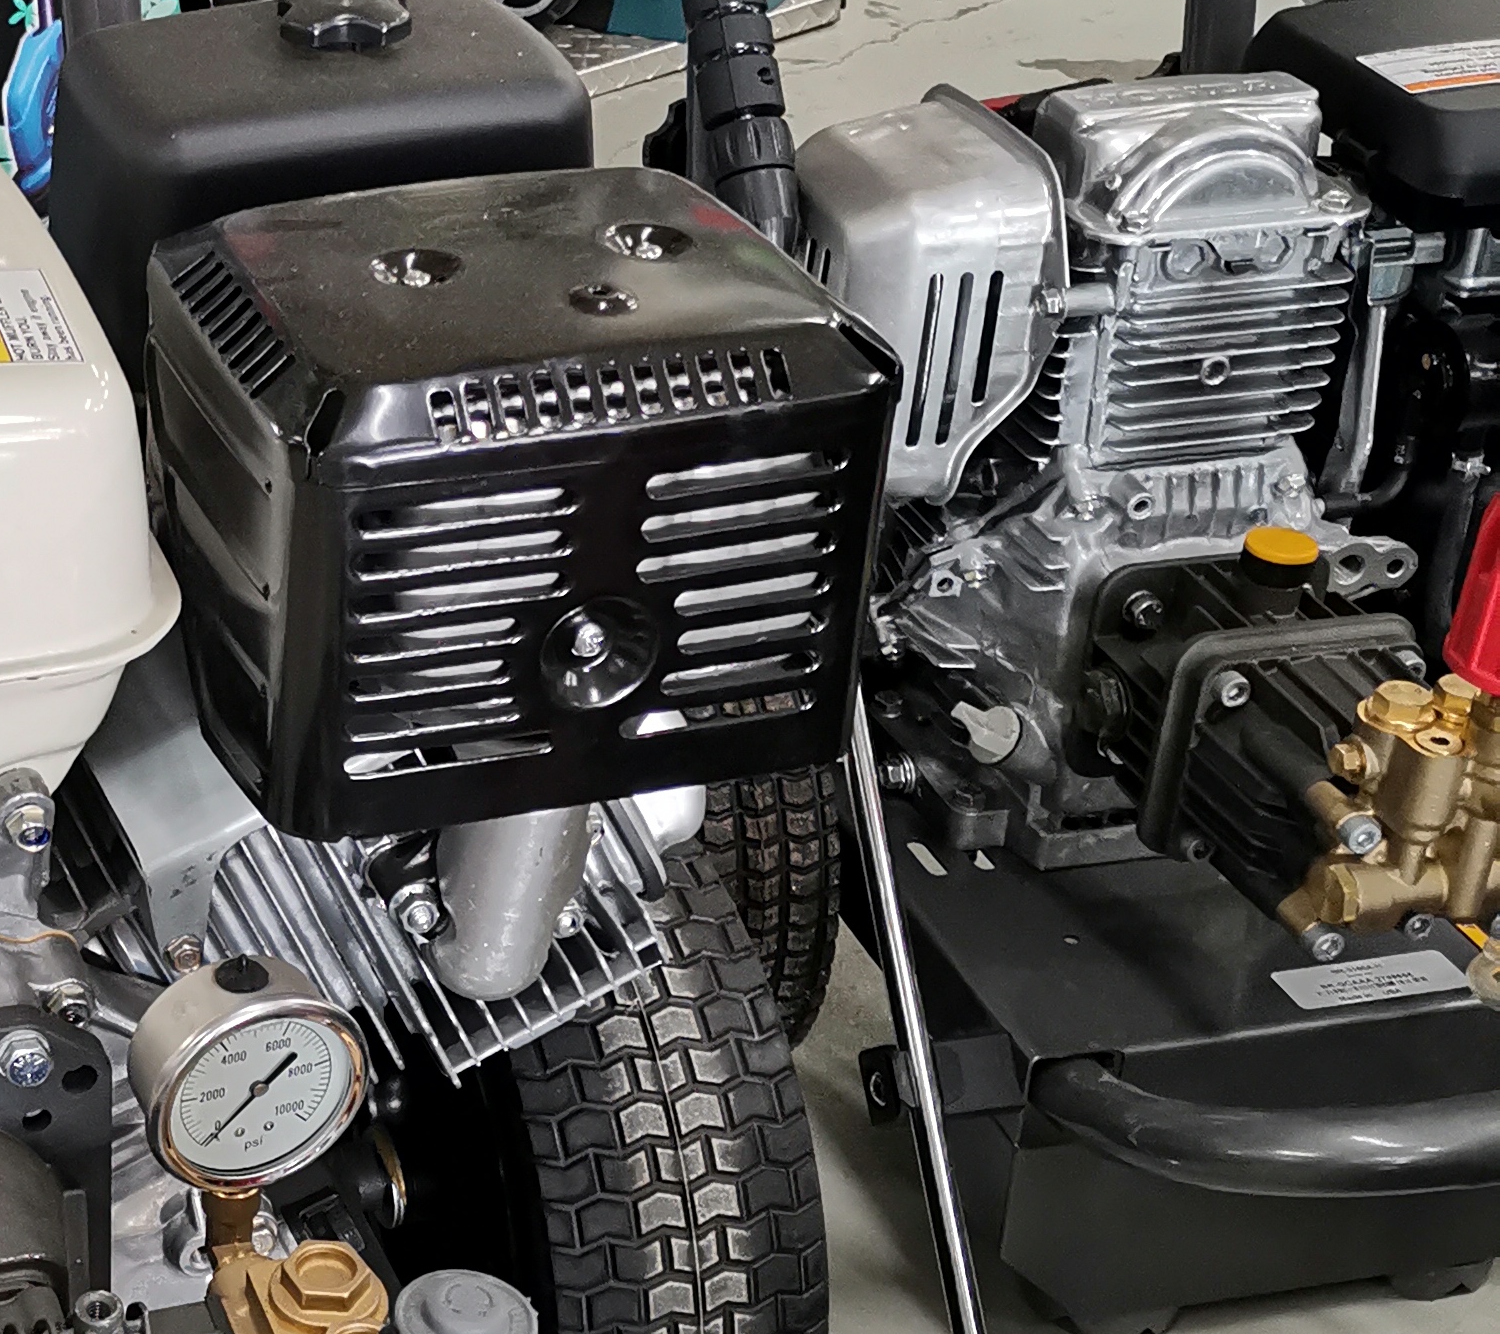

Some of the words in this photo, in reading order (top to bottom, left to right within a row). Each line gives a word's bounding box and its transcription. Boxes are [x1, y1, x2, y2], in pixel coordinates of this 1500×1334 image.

[266, 1037, 291, 1052] 6000
[221, 1050, 247, 1065] 4000
[288, 1062, 312, 1077] 8000
[200, 1087, 225, 1102] 2000
[275, 1100, 304, 1116] 10000
[244, 1136, 263, 1151] psi
